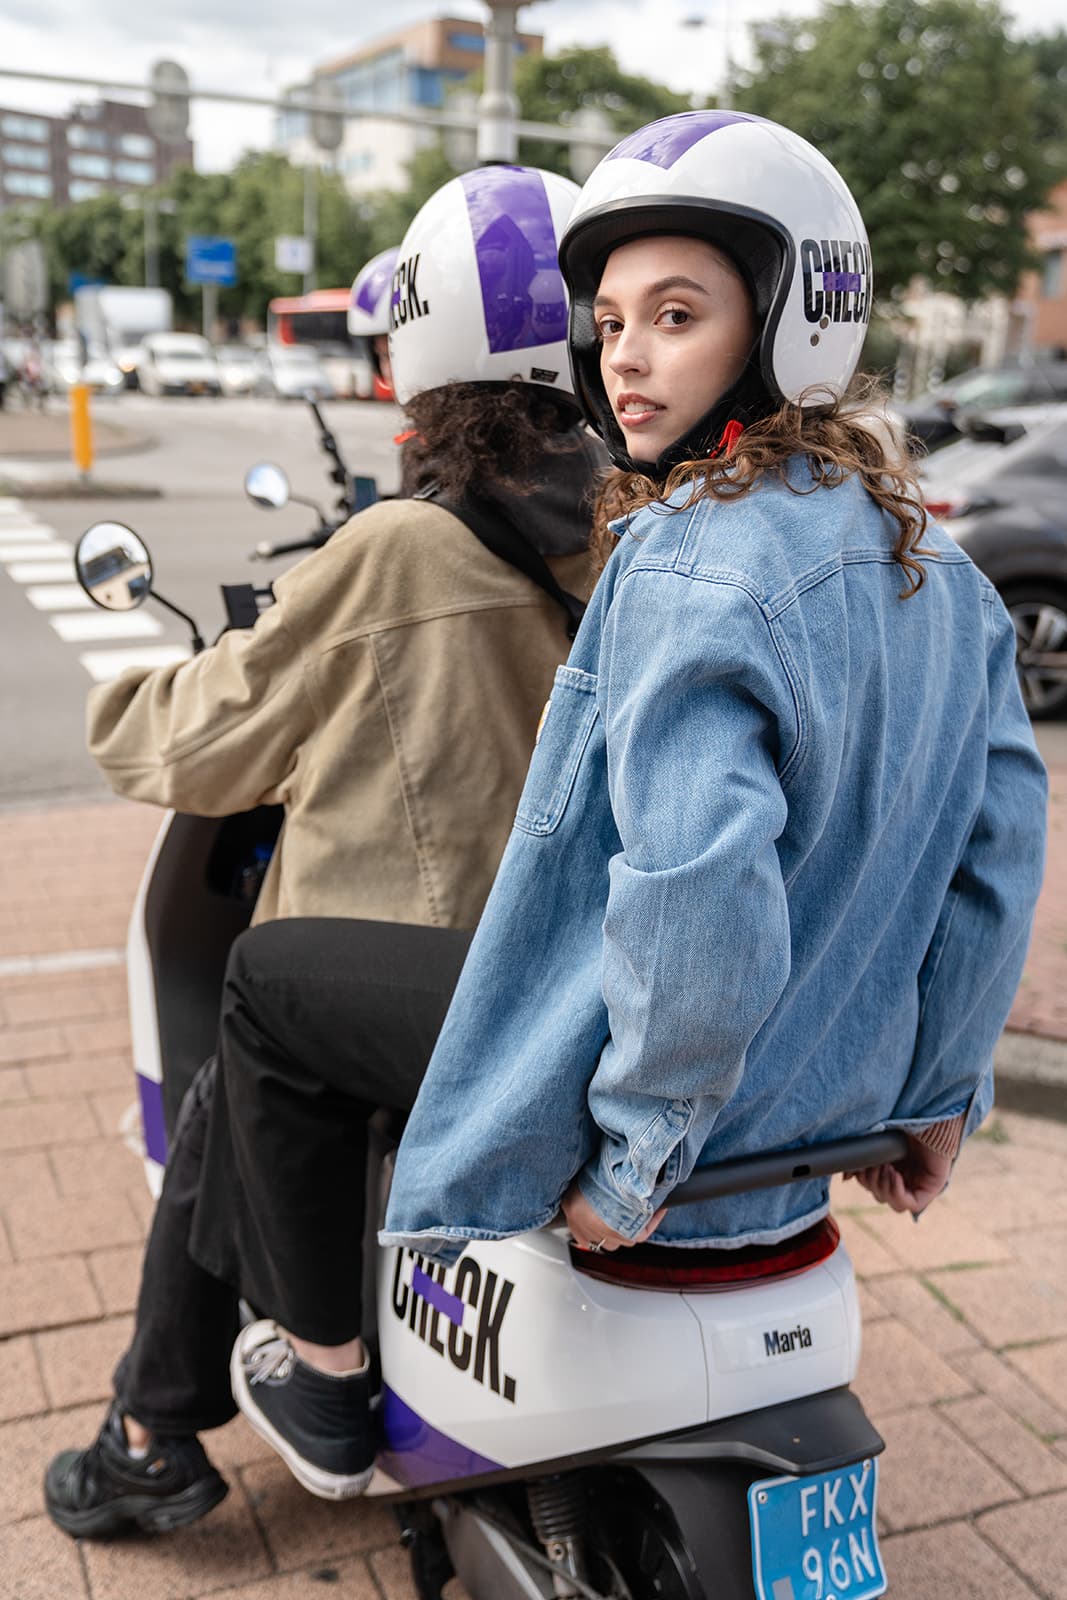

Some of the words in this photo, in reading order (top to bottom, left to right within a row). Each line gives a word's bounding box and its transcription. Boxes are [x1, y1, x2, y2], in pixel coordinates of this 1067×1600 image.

[763, 1325, 812, 1356] Maria
[801, 1470, 869, 1537] FKX
[802, 1527, 876, 1600] 96N
